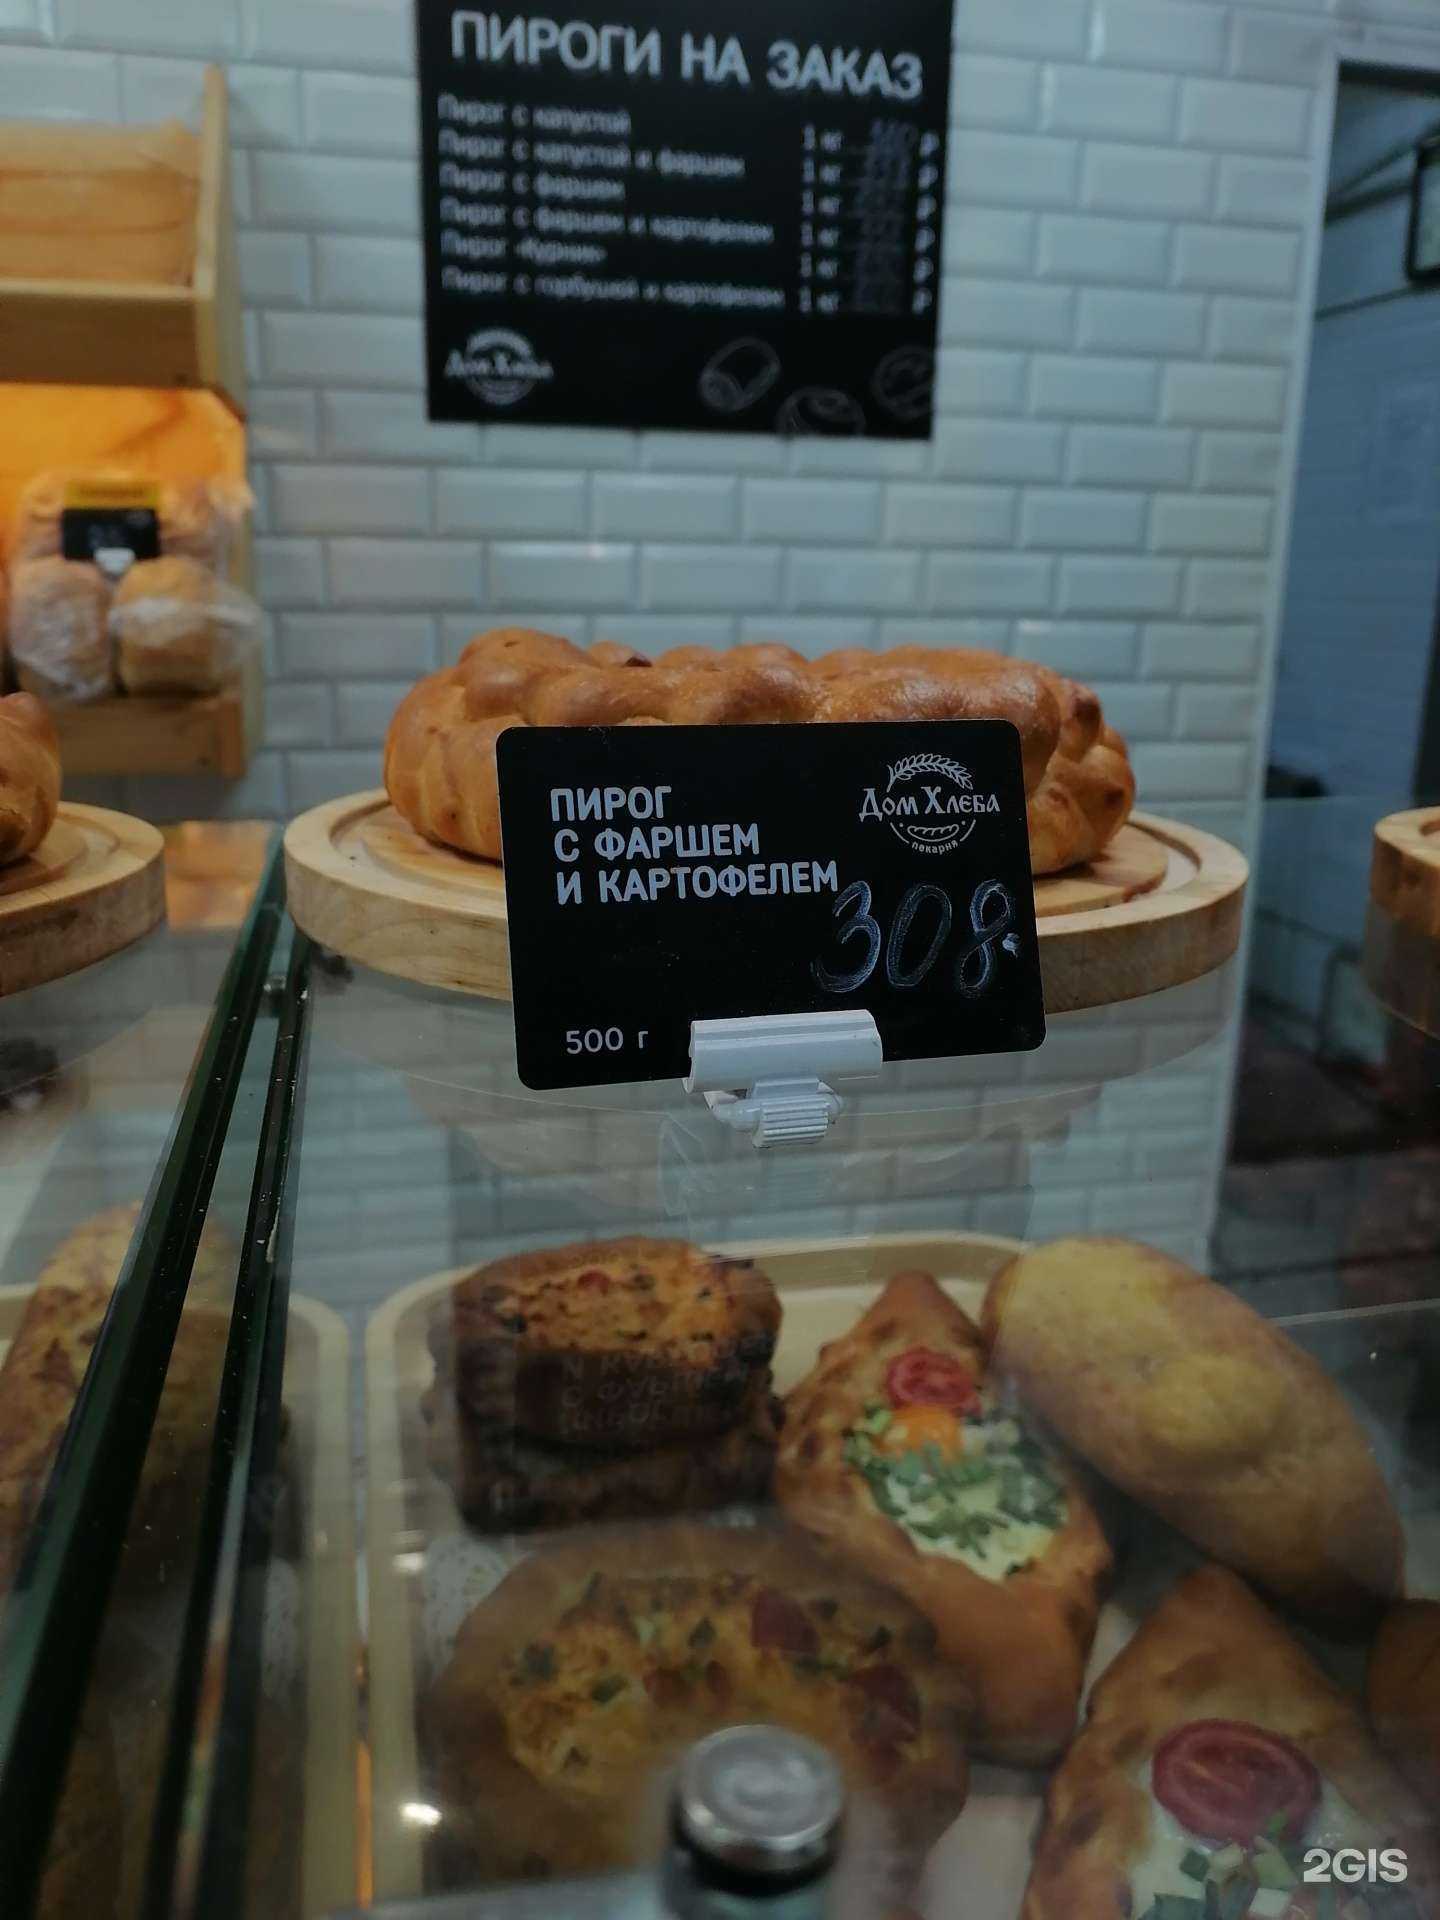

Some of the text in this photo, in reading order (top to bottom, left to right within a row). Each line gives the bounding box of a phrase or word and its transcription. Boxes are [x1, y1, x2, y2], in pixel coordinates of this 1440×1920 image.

[451, 10, 924, 100] ПИРОГИ НА ЗАКАЗ
[550, 785, 672, 821] ПИРОГ
[859, 788, 919, 822] Дом
[554, 823, 760, 862] С ФАРШЕМ
[911, 840, 959, 855] пекарня
[556, 860, 839, 905] И КАРТОФЕЛЕМ
[566, 1027, 649, 1054] 500 г
